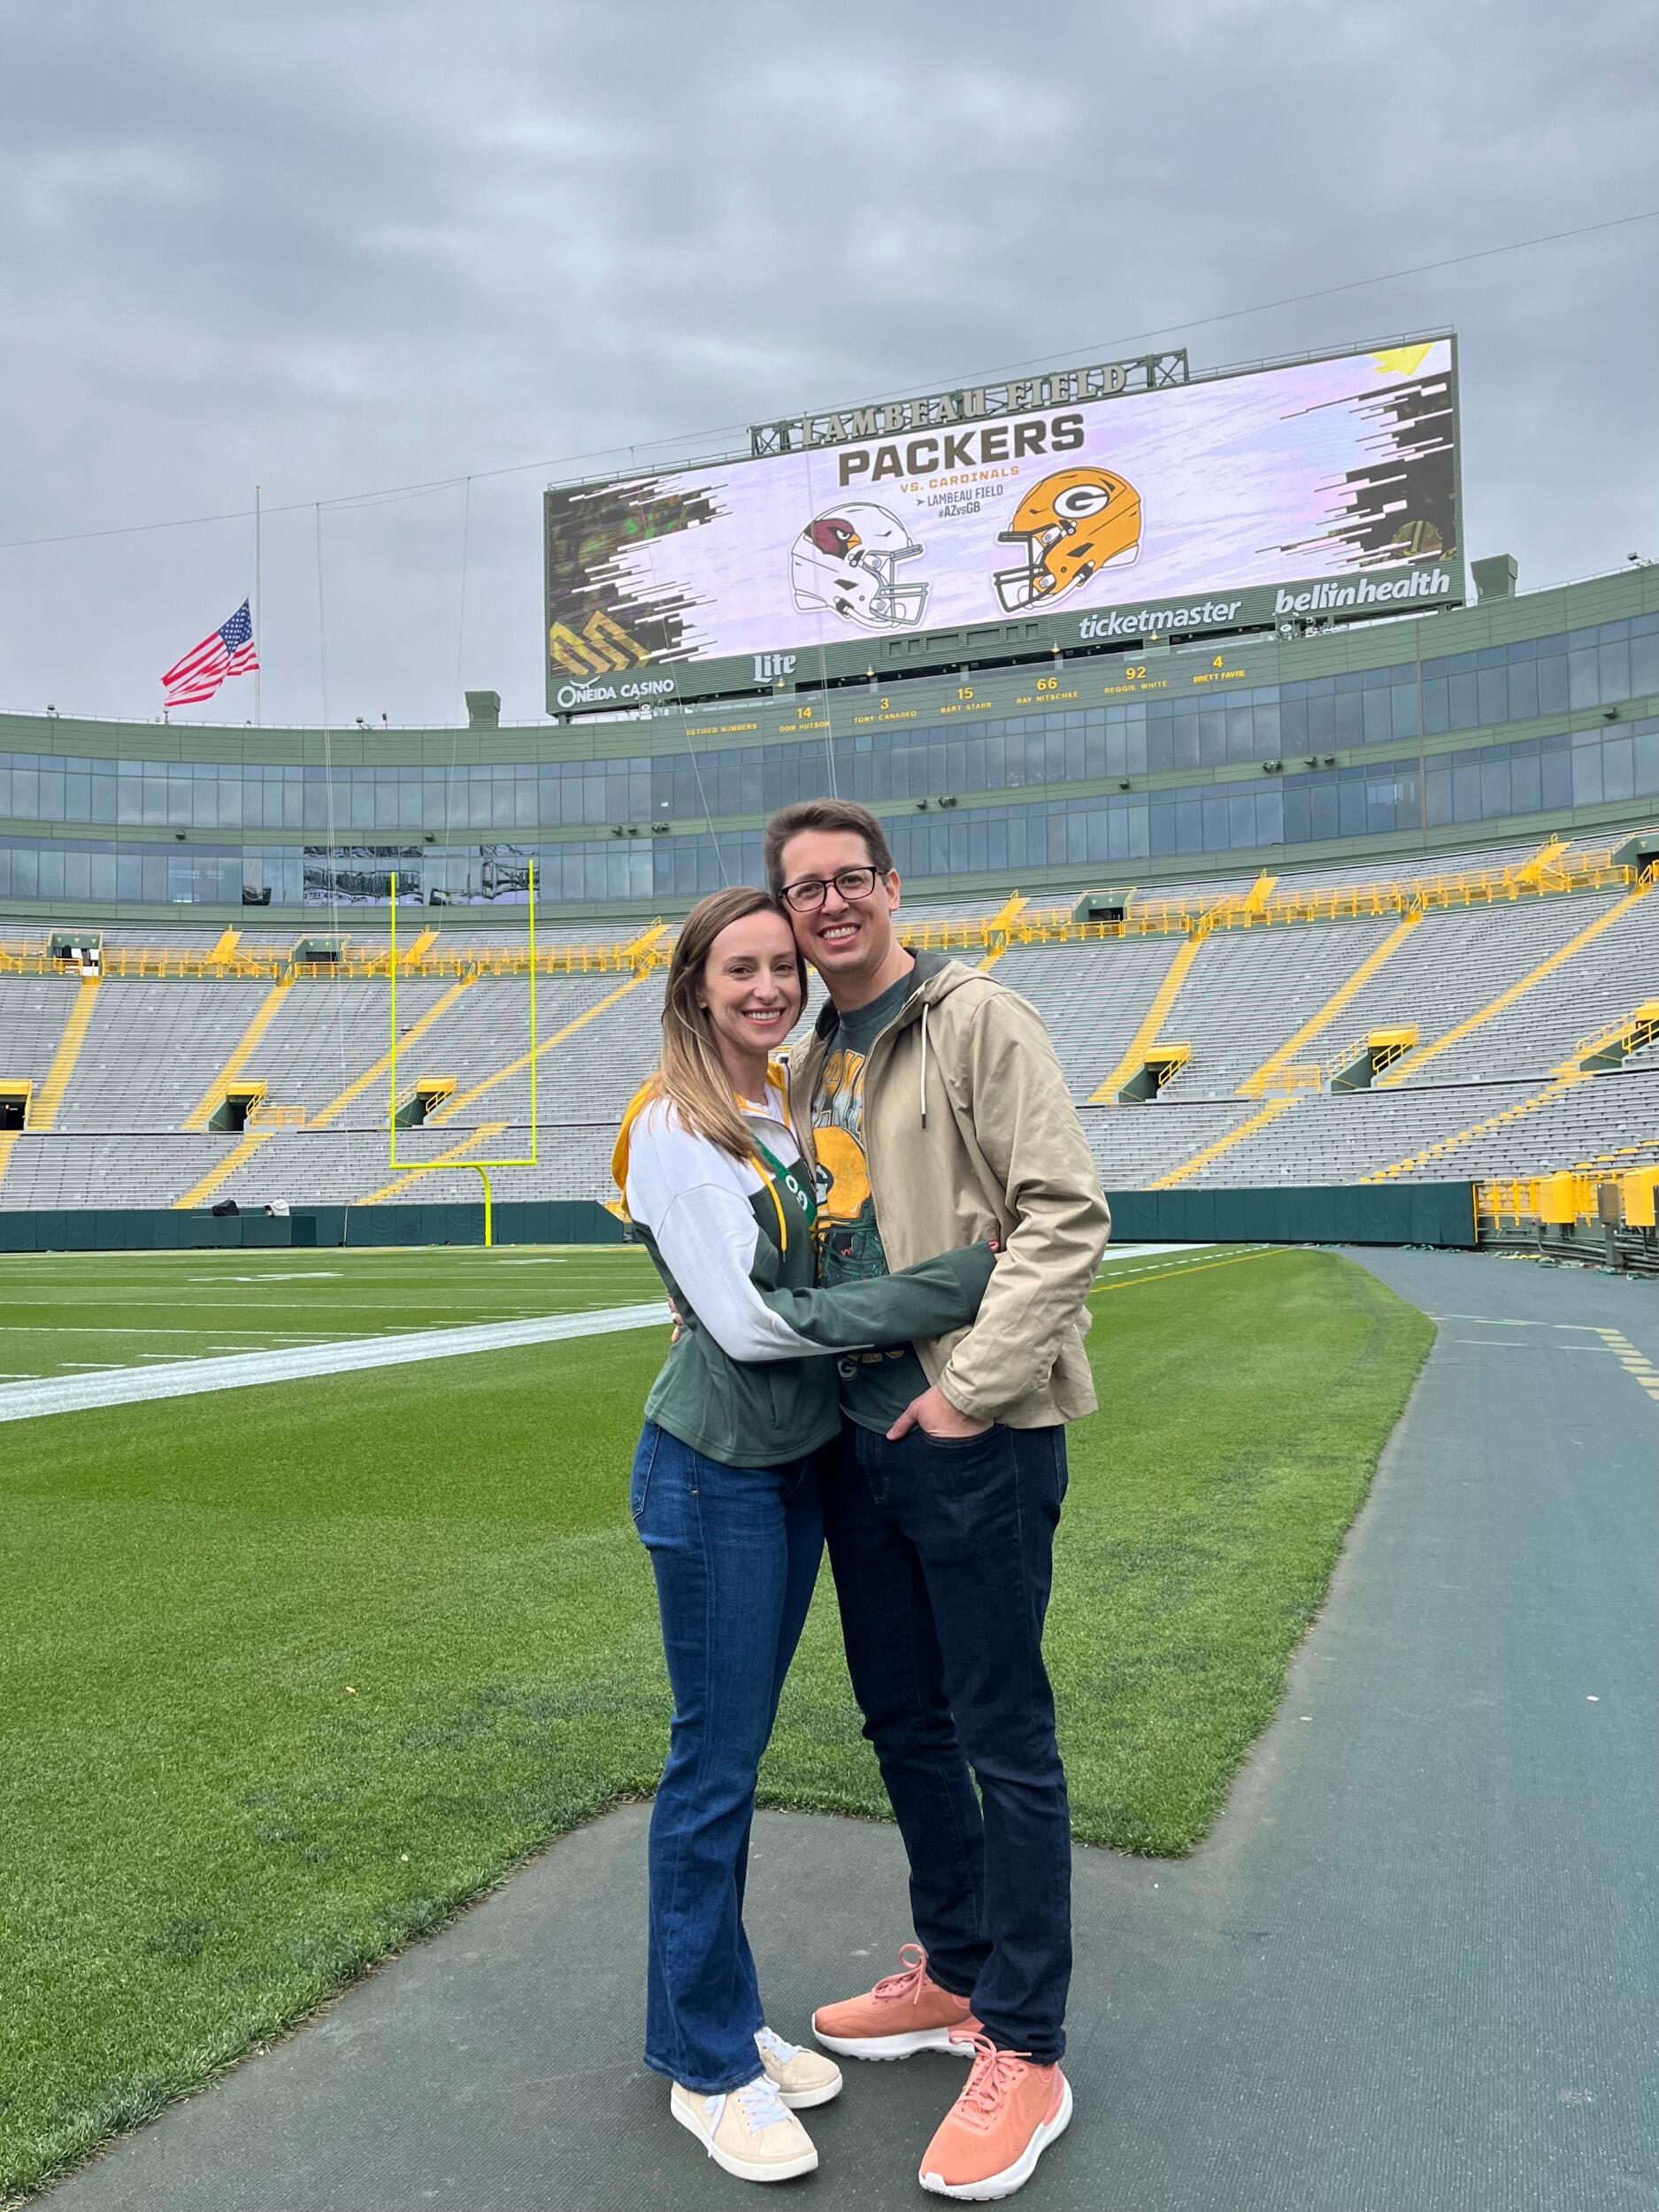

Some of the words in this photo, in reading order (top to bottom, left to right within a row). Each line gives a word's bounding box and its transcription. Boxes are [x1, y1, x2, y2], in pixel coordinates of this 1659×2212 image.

[802, 388, 987, 445] LAMBEAU
[1007, 365, 1126, 411] FIELD
[839, 413, 1085, 487] PACKERS
[900, 481, 925, 493] VS.
[929, 465, 1019, 488] CARDINALS
[927, 489, 972, 506] LAMBEAU
[975, 484, 1003, 498] FIELD
[938, 502, 980, 518] #AZvsGB
[1079, 601, 1241, 640] ticketmaster
[753, 654, 796, 683] Lite
[1213, 655, 1224, 668] 4
[1125, 665, 1147, 680] 92
[1193, 672, 1218, 683] BRETT
[1221, 669, 1247, 680] FAVRE
[620, 679, 675, 698] CASINO
[1036, 677, 1058, 691] 66
[1104, 684, 1137, 695] REGGIE
[1141, 680, 1169, 690] WHITE
[956, 687, 973, 701] 15
[1016, 696, 1033, 705] RAY
[1036, 690, 1079, 703] NITSCHKE
[880, 697, 890, 710] 3
[941, 705, 962, 714] BART
[965, 702, 992, 710] STARR
[797, 706, 812, 719] 14
[854, 715, 874, 724] TONY
[879, 710, 918, 721] CANADEO
[799, 721, 830, 731] HUTSON
